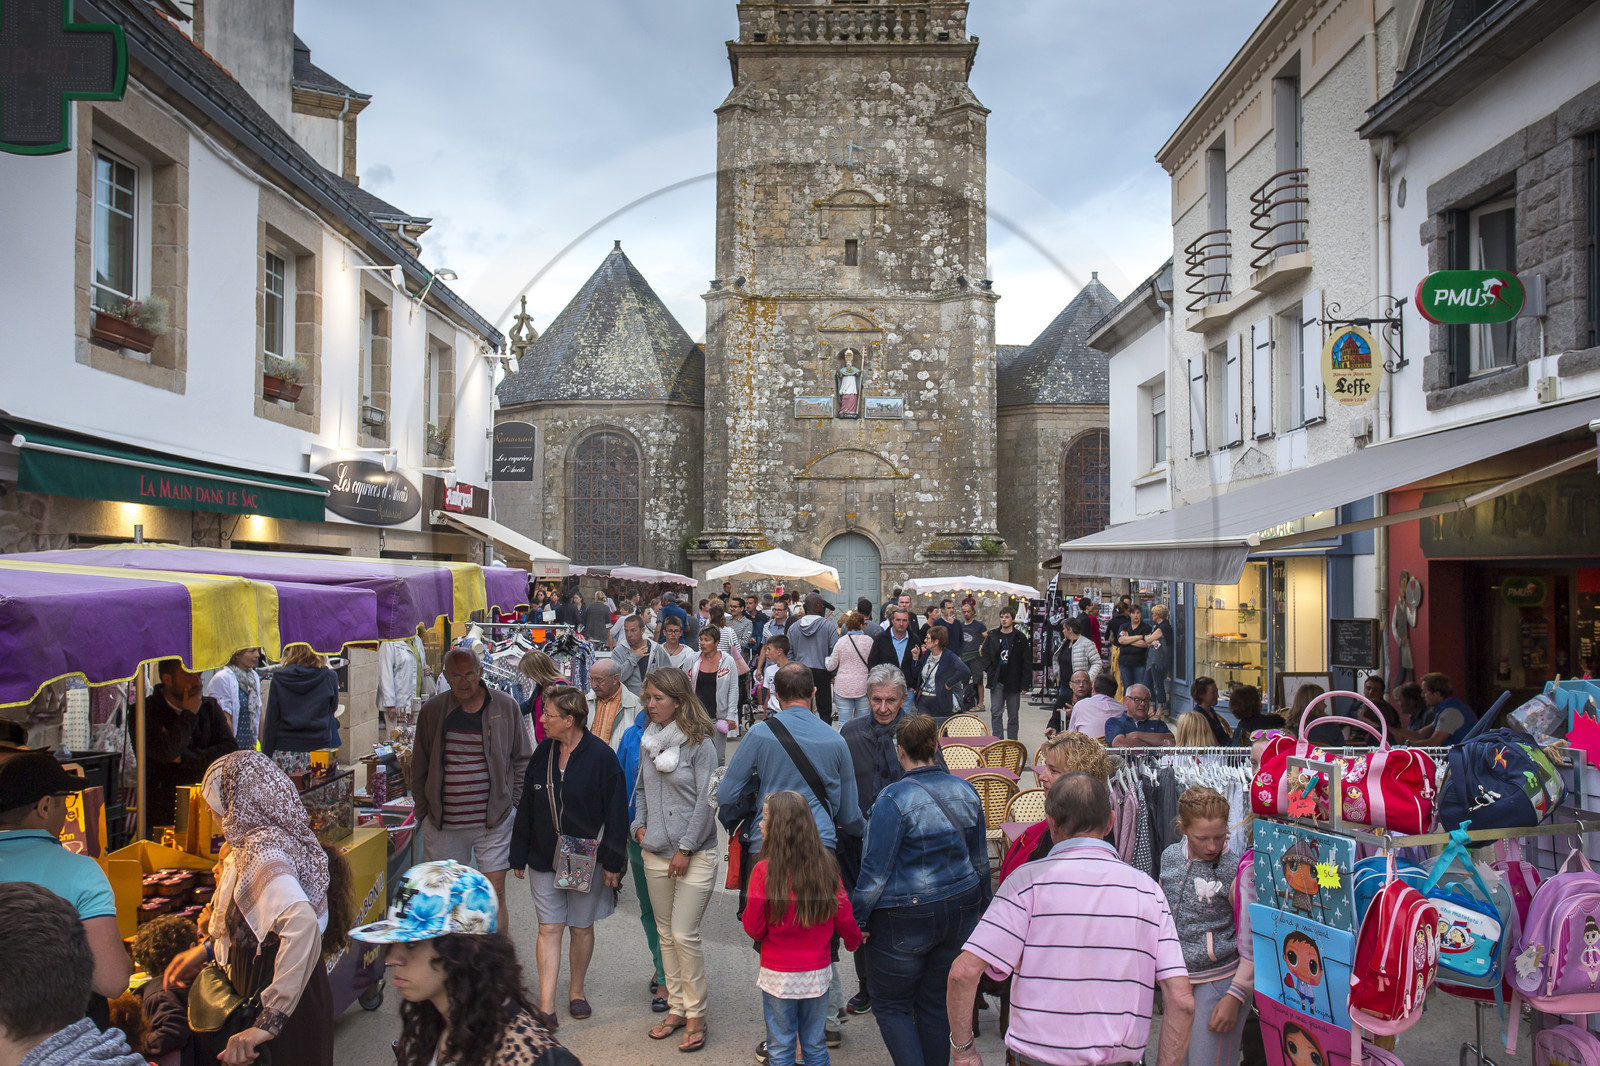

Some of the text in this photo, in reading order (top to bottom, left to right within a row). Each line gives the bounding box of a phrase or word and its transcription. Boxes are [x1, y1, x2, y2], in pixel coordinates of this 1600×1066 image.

[1434, 288, 1481, 307] PMU
[1334, 377, 1371, 397] Leffe
[495, 453, 533, 464] Les caprices
[140, 474, 259, 509] LA MAIN DANS LE SAC
[332, 462, 351, 493] Les
[351, 480, 380, 503] caprices
[363, 878, 379, 917] BON
